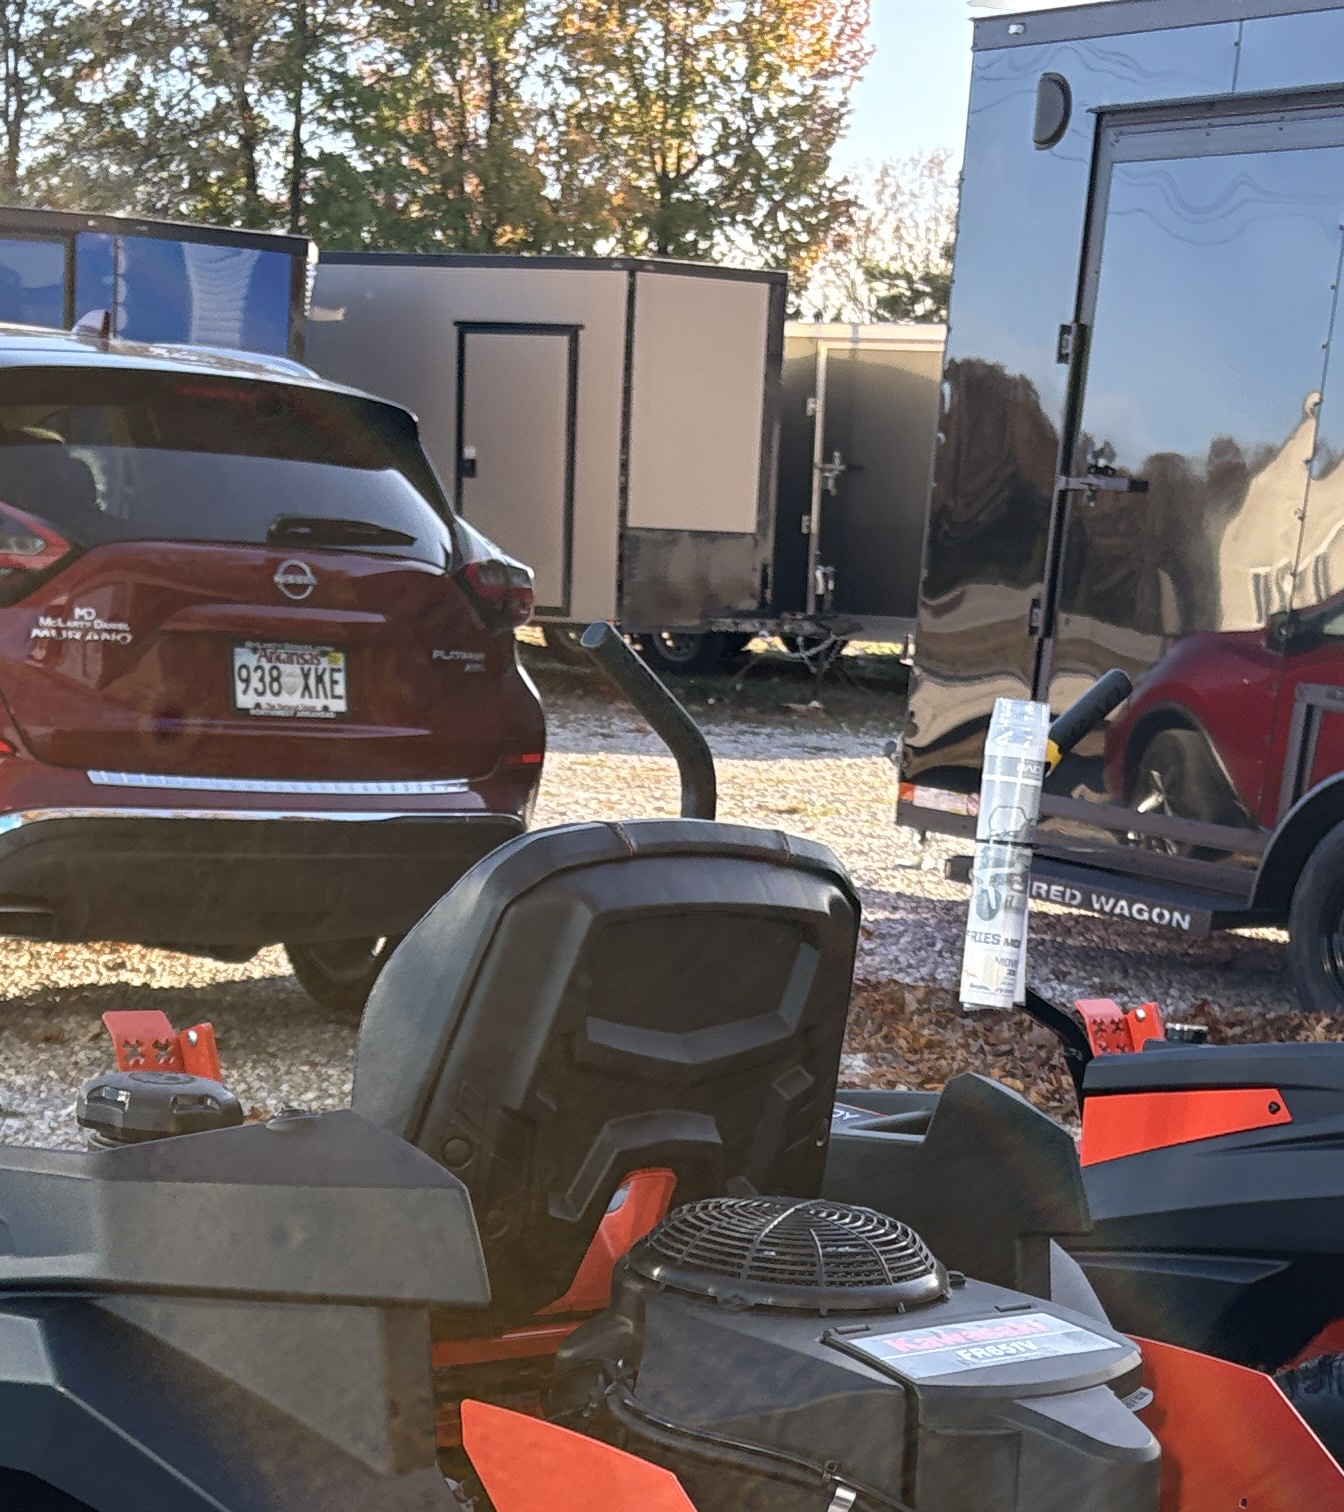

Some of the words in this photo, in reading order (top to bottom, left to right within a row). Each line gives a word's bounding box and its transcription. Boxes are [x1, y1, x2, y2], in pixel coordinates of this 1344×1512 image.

[30, 628, 133, 645] MURANO
[238, 664, 282, 697] 938
[300, 667, 344, 699] XKE
[1031, 881, 1083, 906] RED
[1091, 893, 1192, 931] WAGON
[883, 1319, 1051, 1353] Kawasaki
[955, 1339, 1039, 1363] FR651V
